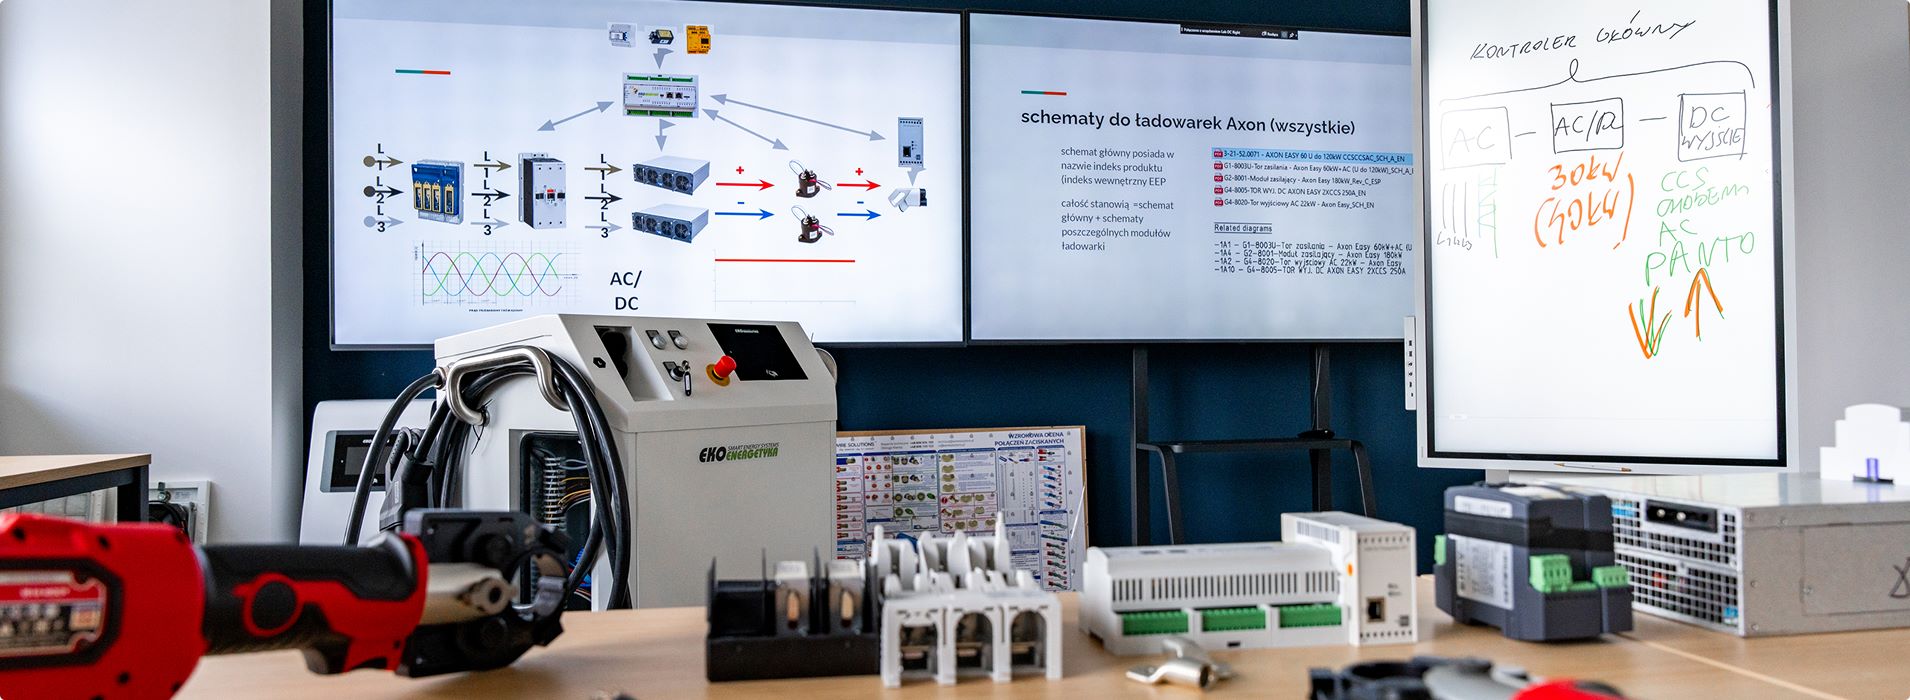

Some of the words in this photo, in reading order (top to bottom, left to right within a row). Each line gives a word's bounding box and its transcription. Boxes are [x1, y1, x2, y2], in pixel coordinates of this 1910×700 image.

[1471, 35, 1577, 60] KONTROLER
[1021, 110, 1104, 130] schematy
[1109, 112, 1131, 127] do
[1135, 114, 1222, 130] ładowarek
[1227, 117, 1266, 132] Axon
[1270, 119, 1355, 136] (wszystkie)
[1690, 107, 1730, 128] DC
[1449, 126, 1495, 156] AC
[1061, 147, 1097, 156] schemat
[1099, 148, 1131, 158] główny
[1132, 149, 1165, 159] posiada
[1061, 162, 1092, 170] nazwie
[1094, 162, 1121, 171] indeks
[1123, 163, 1163, 173] produktu
[1310, 165, 1322, 173] Easy
[1061, 175, 1092, 185] (indeks
[1094, 177, 1147, 186] wewnętrzny
[1149, 177, 1166, 186] EEP
[1270, 176, 1297, 185] zasilający
[1662, 167, 1708, 192] CCS
[1061, 199, 1089, 208] całość
[1090, 200, 1130, 210] stanowią
[1133, 201, 1174, 210] =schemat
[1260, 199, 1289, 208] wyjściowy
[1061, 213, 1093, 223] główny
[1103, 214, 1144, 224] schematy
[1062, 228, 1129, 238] poszczególnych
[1131, 229, 1171, 238] modułów
[1215, 224, 1241, 232] Related
[1243, 225, 1272, 233] diagrams
[1660, 219, 1698, 247] AC
[1062, 242, 1105, 251] ładowarki
[1356, 244, 1370, 252] Easy
[1301, 251, 1334, 260] zasilający
[1365, 252, 1380, 260] Easy
[1646, 232, 1754, 287] PANTO
[1387, 260, 1401, 268] Easy
[610, 270, 643, 289] AC/
[615, 297, 639, 310] DC
[699, 446, 727, 463] EKO
[726, 447, 779, 461] ENERGETYKA
